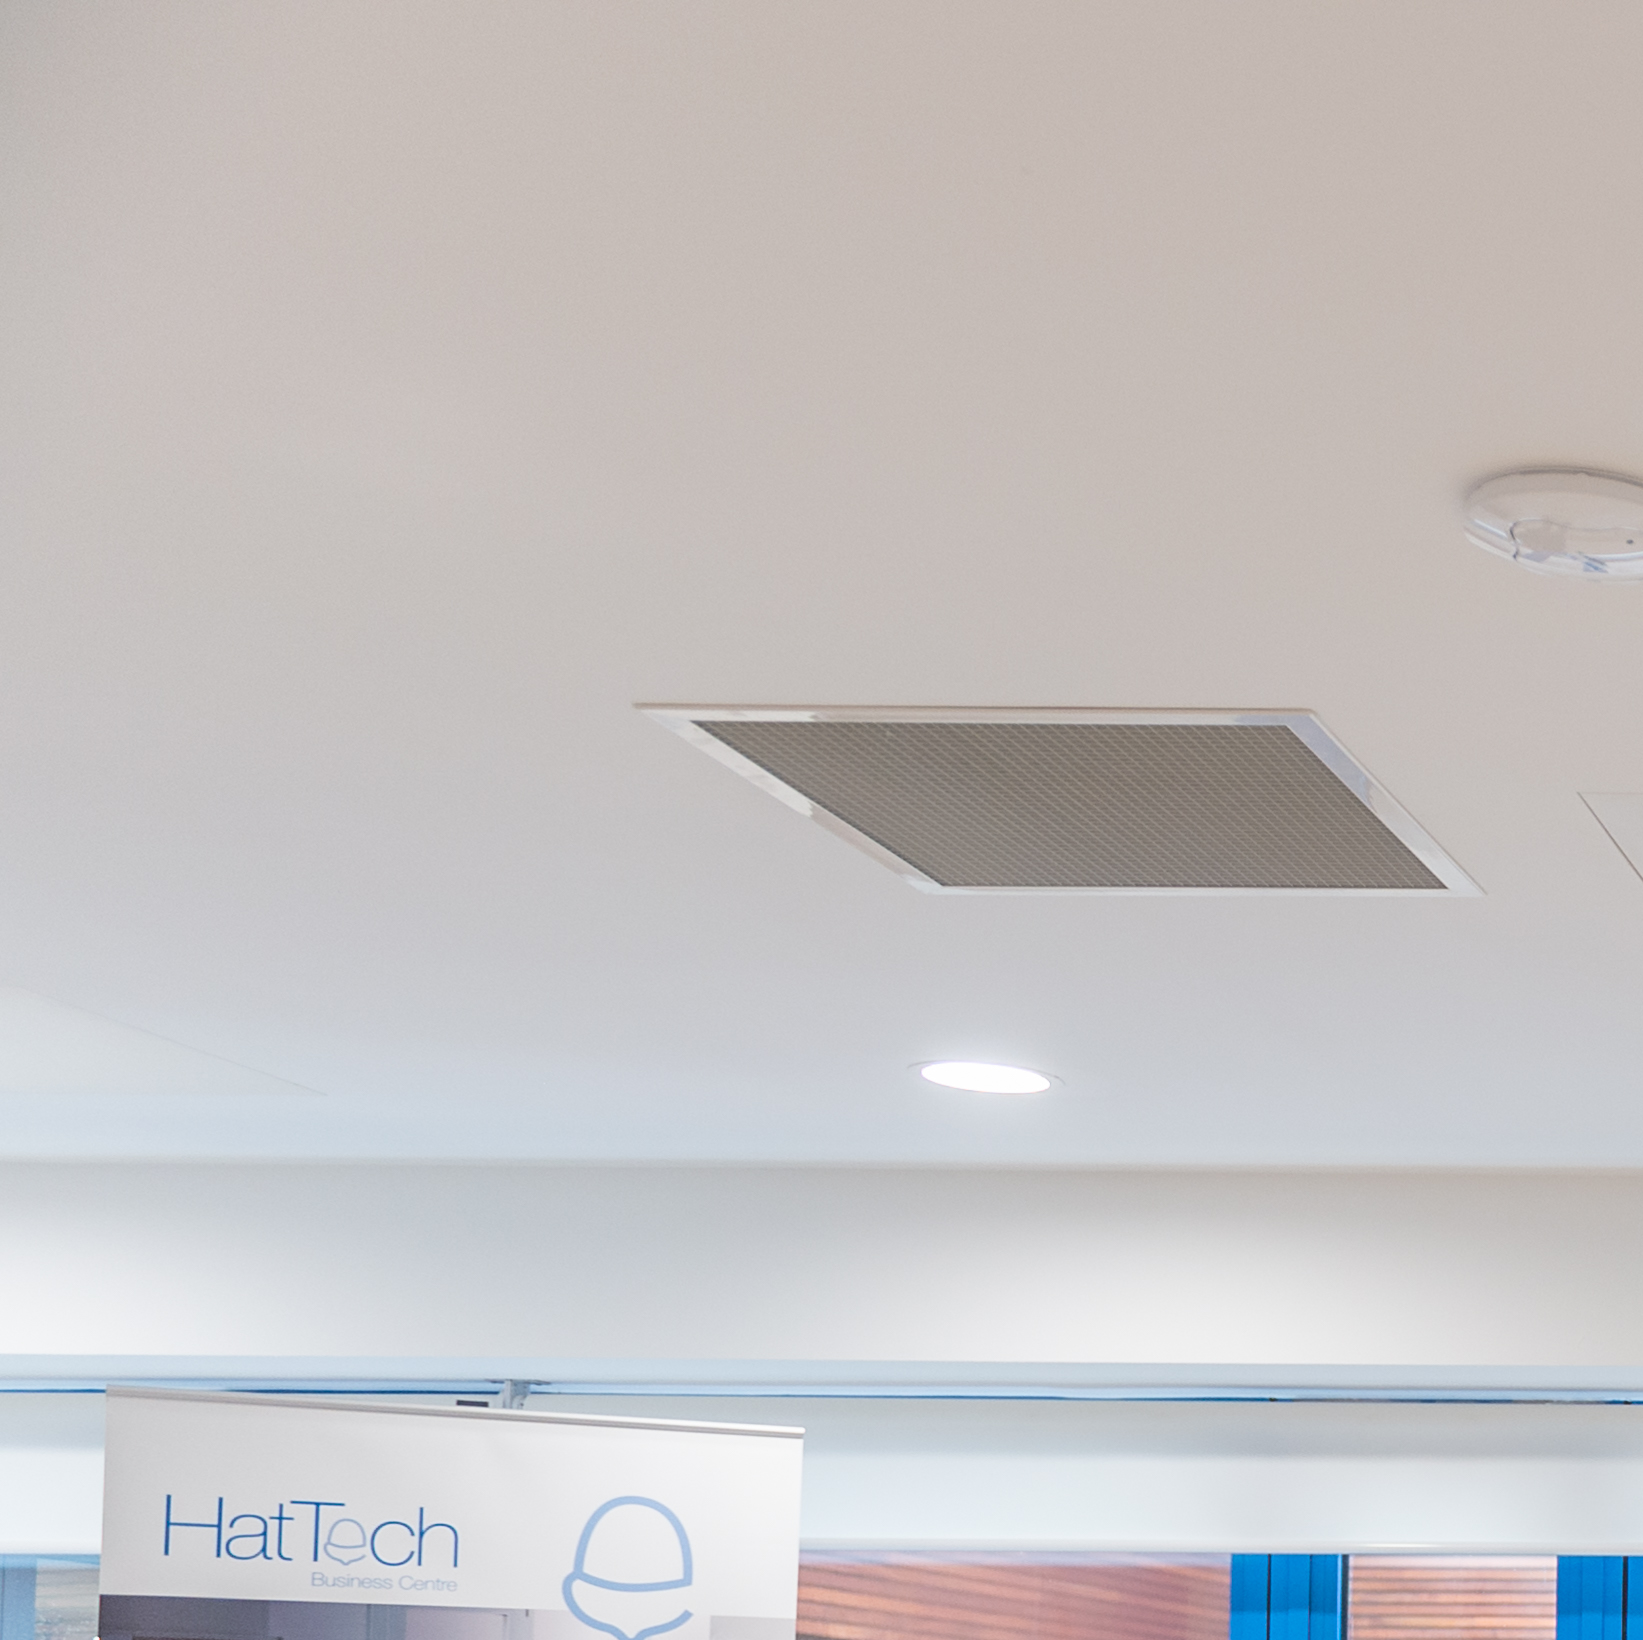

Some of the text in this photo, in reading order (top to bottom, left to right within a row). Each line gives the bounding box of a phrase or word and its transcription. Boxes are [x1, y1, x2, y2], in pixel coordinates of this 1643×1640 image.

[164, 1494, 458, 1567] HatTech
[311, 1572, 457, 1592] Business Centre
